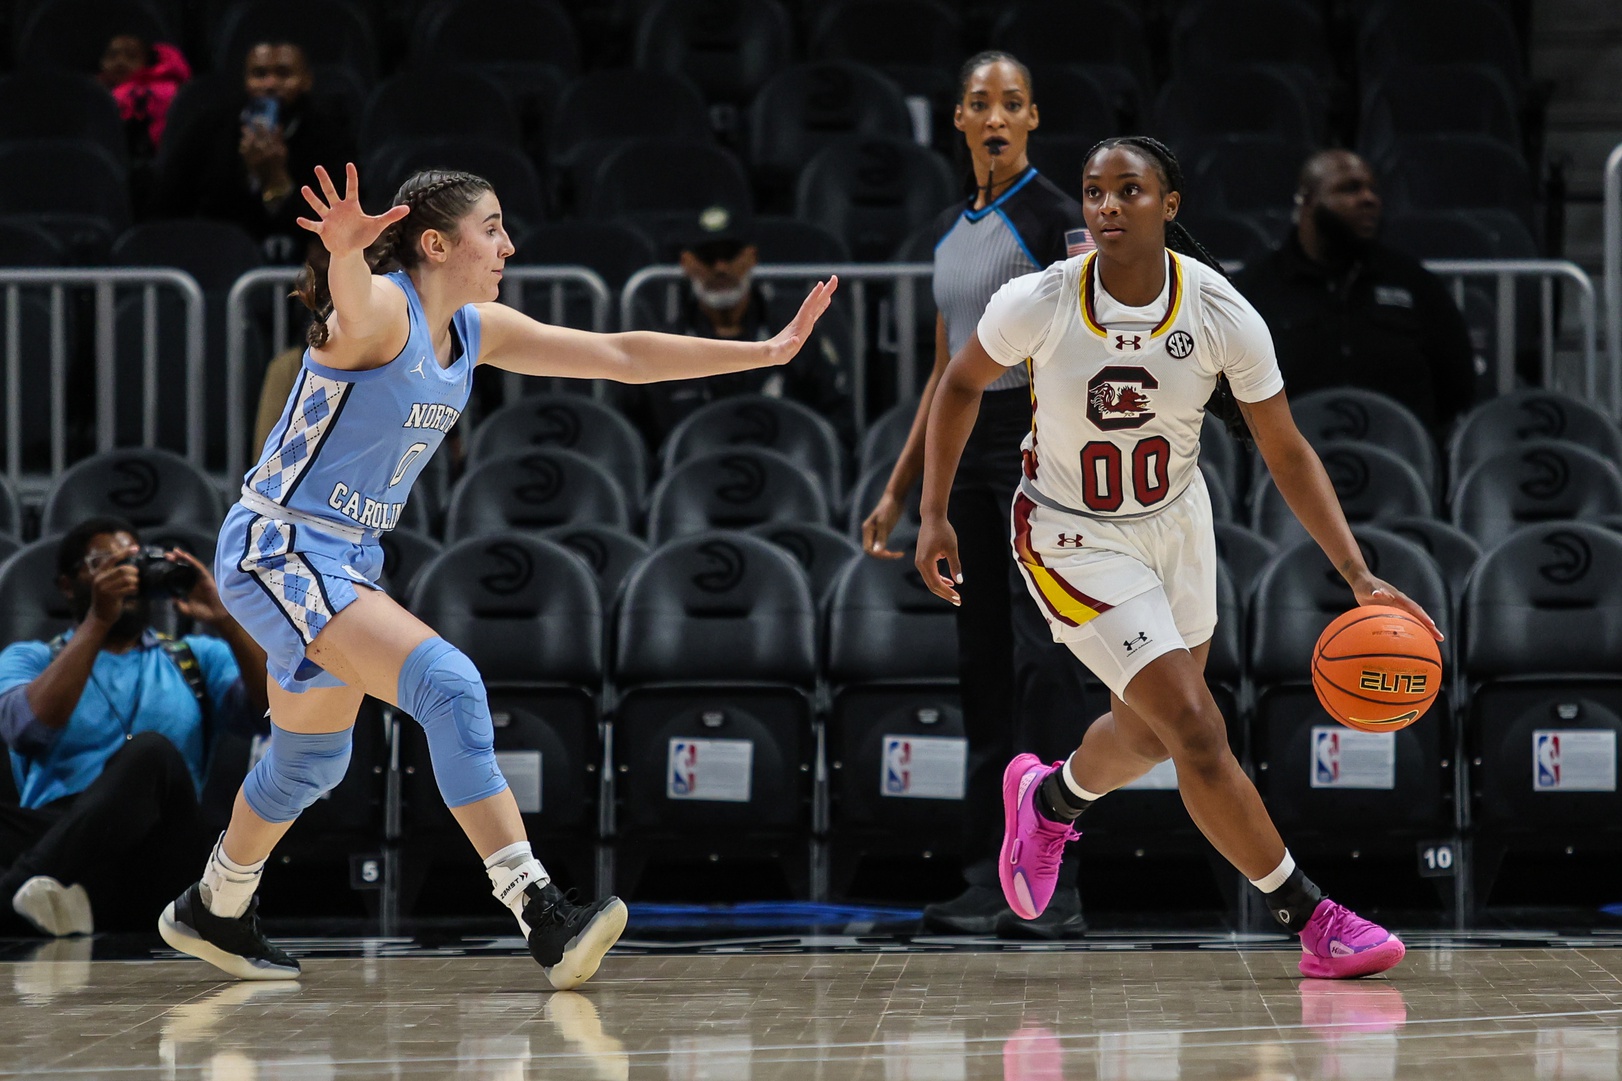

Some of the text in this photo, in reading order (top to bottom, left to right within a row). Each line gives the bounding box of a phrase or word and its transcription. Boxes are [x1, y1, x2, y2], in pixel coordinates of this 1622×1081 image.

[1167, 332, 1193, 358] SEC
[403, 403, 460, 434] NORTH
[389, 442, 428, 488] 0
[1080, 435, 1170, 512] 00
[1359, 670, 1427, 694] ELITE
[362, 860, 379, 882] 5
[1423, 847, 1452, 869] 10
